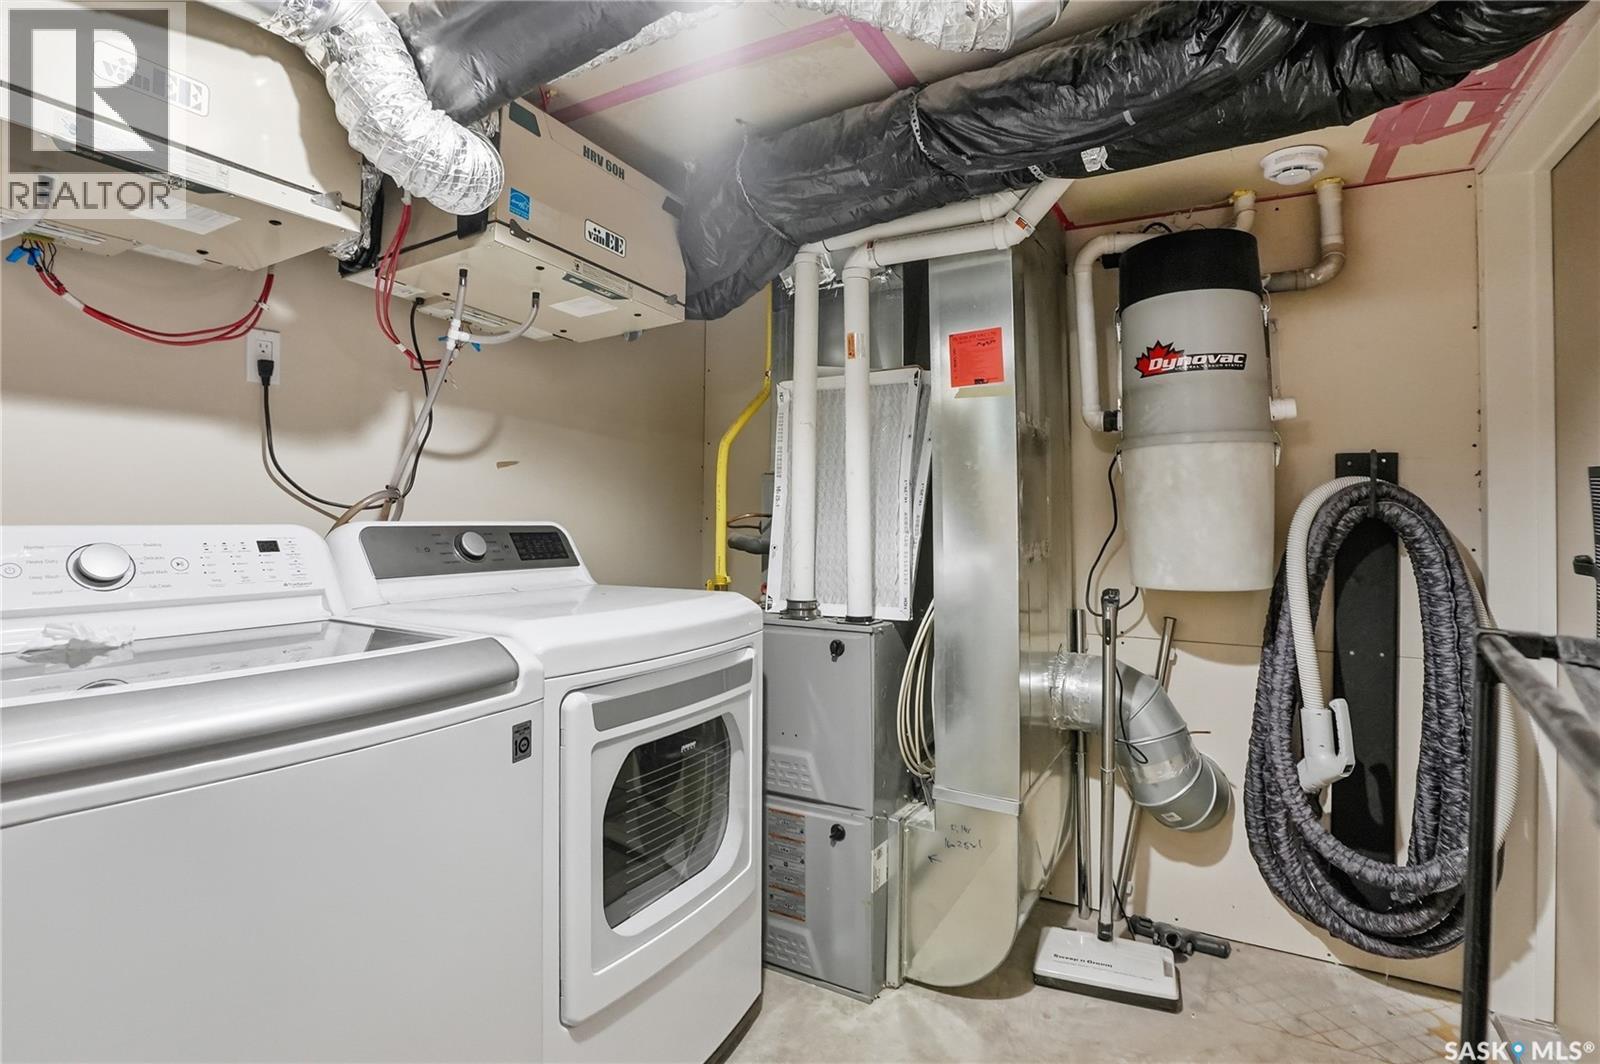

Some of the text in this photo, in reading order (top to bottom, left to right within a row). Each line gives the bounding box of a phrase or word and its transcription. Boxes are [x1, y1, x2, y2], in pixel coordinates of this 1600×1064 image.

[583, 145, 625, 181] HRV 60H
[1148, 354, 1244, 371] Dynovac
